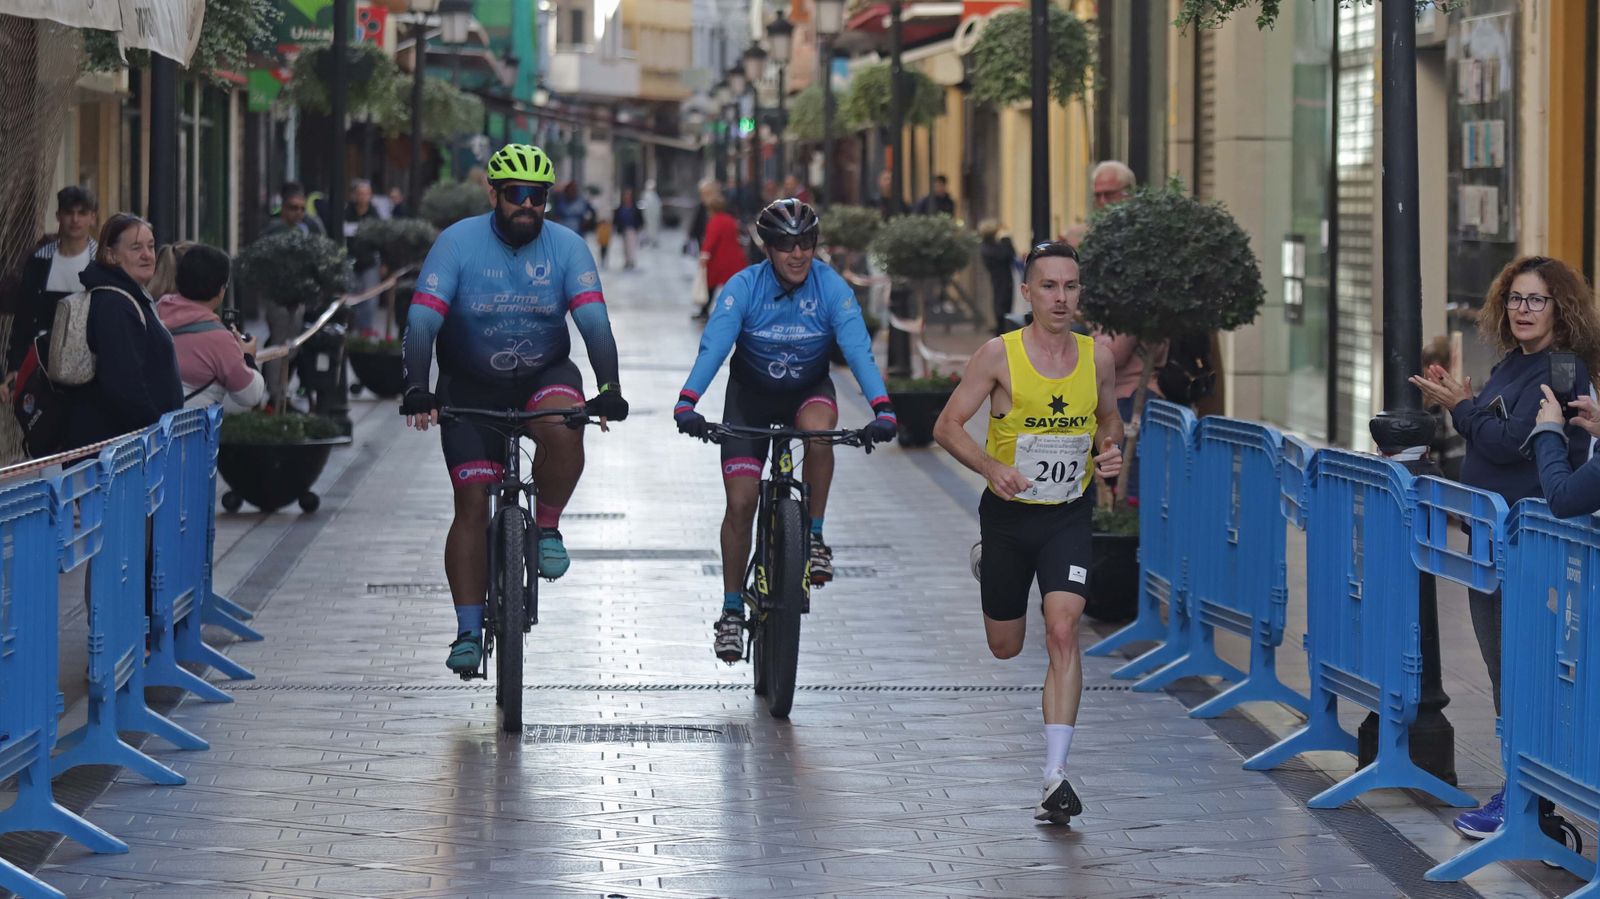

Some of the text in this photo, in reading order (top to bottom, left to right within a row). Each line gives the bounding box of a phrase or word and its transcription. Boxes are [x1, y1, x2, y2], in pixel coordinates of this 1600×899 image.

[290, 25, 335, 43] Unicaj
[1024, 416, 1088, 428] SAYSKY
[1034, 460, 1078, 483] 202
